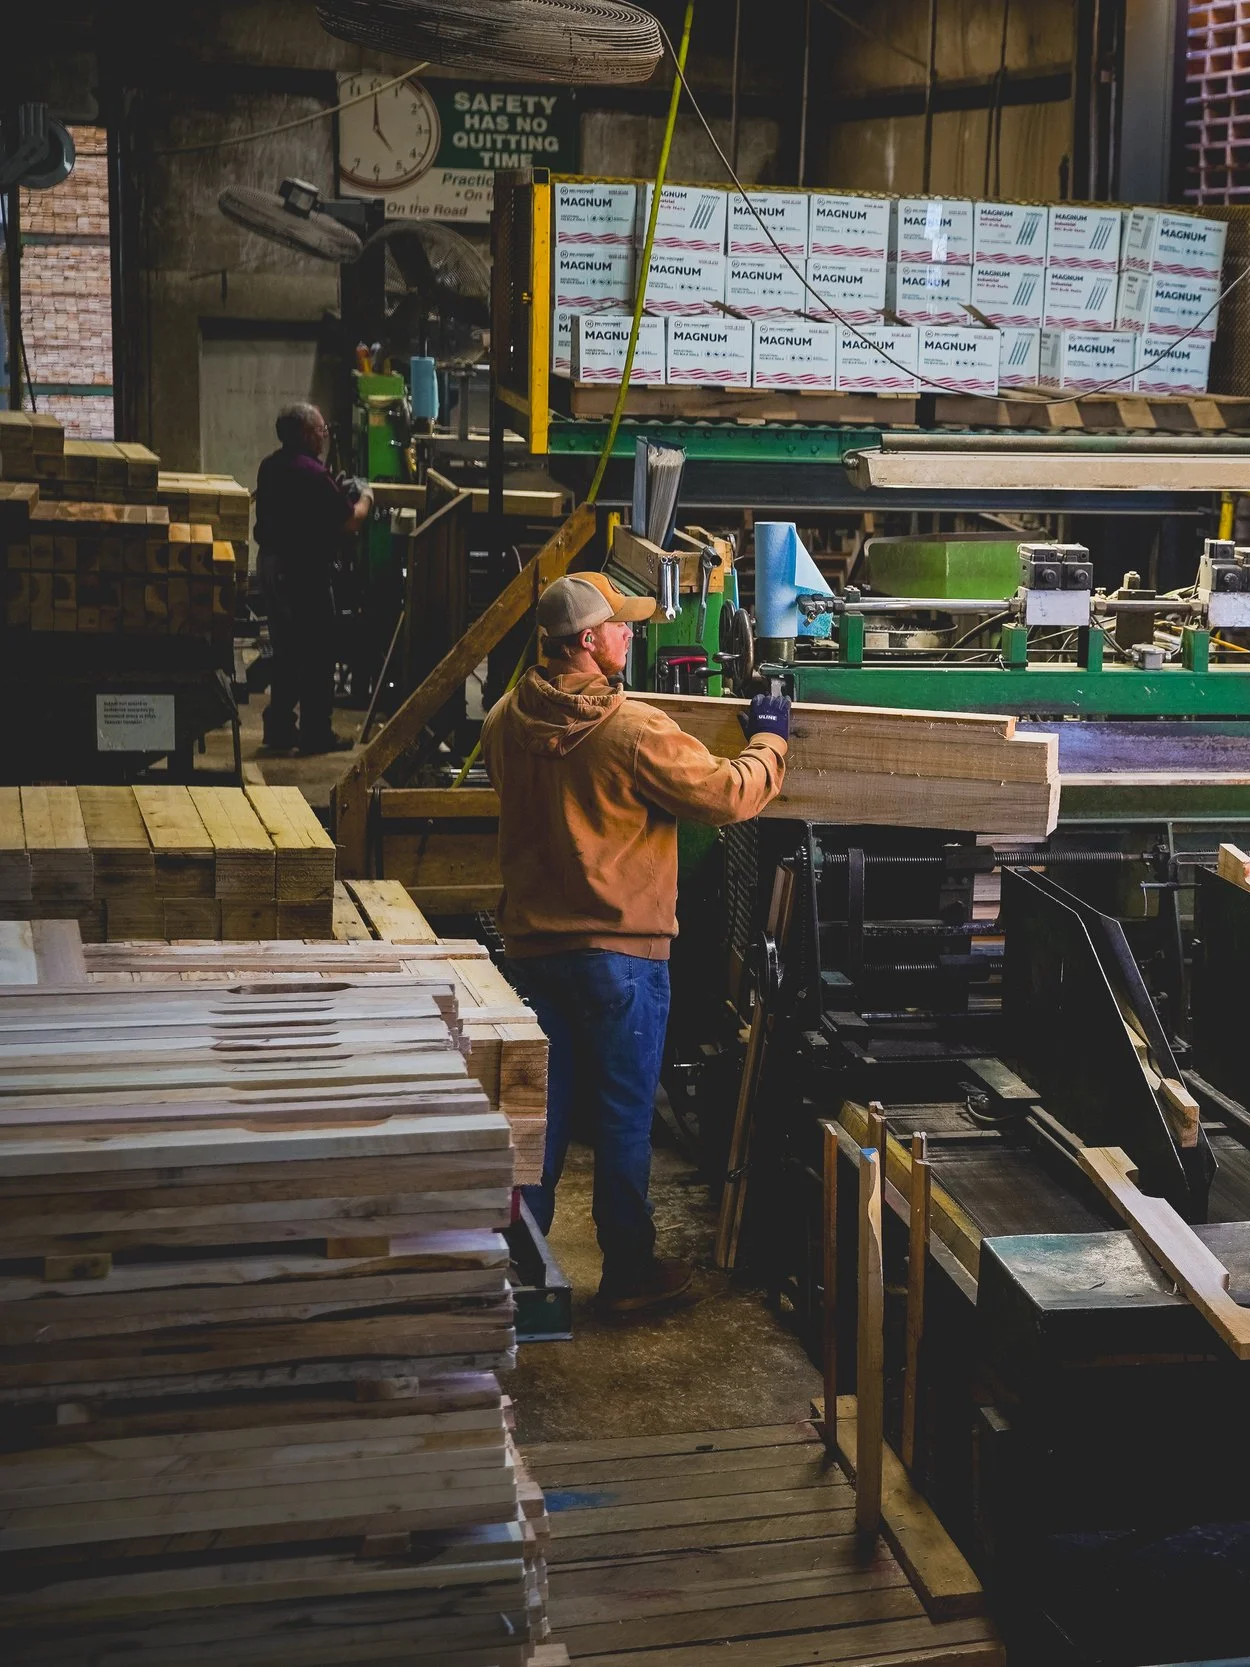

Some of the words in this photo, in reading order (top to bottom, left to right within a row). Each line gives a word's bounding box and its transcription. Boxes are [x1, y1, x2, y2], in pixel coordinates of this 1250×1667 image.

[454, 91, 558, 115] SAFETY
[464, 113, 509, 131] HAS
[516, 116, 548, 133] NO
[452, 131, 559, 152] QUITTING
[480, 151, 533, 168] TIME
[442, 172, 494, 187] Practic
[464, 189, 483, 201] On
[652, 190, 687, 199] AGNUM
[560, 198, 612, 207] MAGNUM
[386, 201, 405, 214] On
[410, 203, 430, 214] the
[433, 204, 468, 217] Road
[734, 206, 785, 217] MAGNUM
[816, 209, 867, 220] MAGNUM
[981, 209, 1013, 217] MAGNUM
[904, 217, 951, 227] MAGM
[1055, 213, 1087, 222] MAGNUM
[1161, 228, 1207, 242] MAGNUM
[560, 261, 612, 271] MAGNUM
[649, 265, 701, 276] MAGNUM
[731, 270, 782, 281] MAGNUM
[812, 273, 863, 284] MAGNUM
[978, 269, 1010, 278] MAGNUM
[1052, 273, 1084, 282] MAGNUM
[1156, 290, 1201, 302] MAGNUM
[674, 332, 727, 342] MAGNUM
[759, 336, 812, 346] MAGNUM
[842, 340, 894, 350] MAGNUM
[925, 341, 976, 352] MAGNUM
[1068, 344, 1115, 354] MAGNUM
[1144, 348, 1190, 359] MAGNUM
